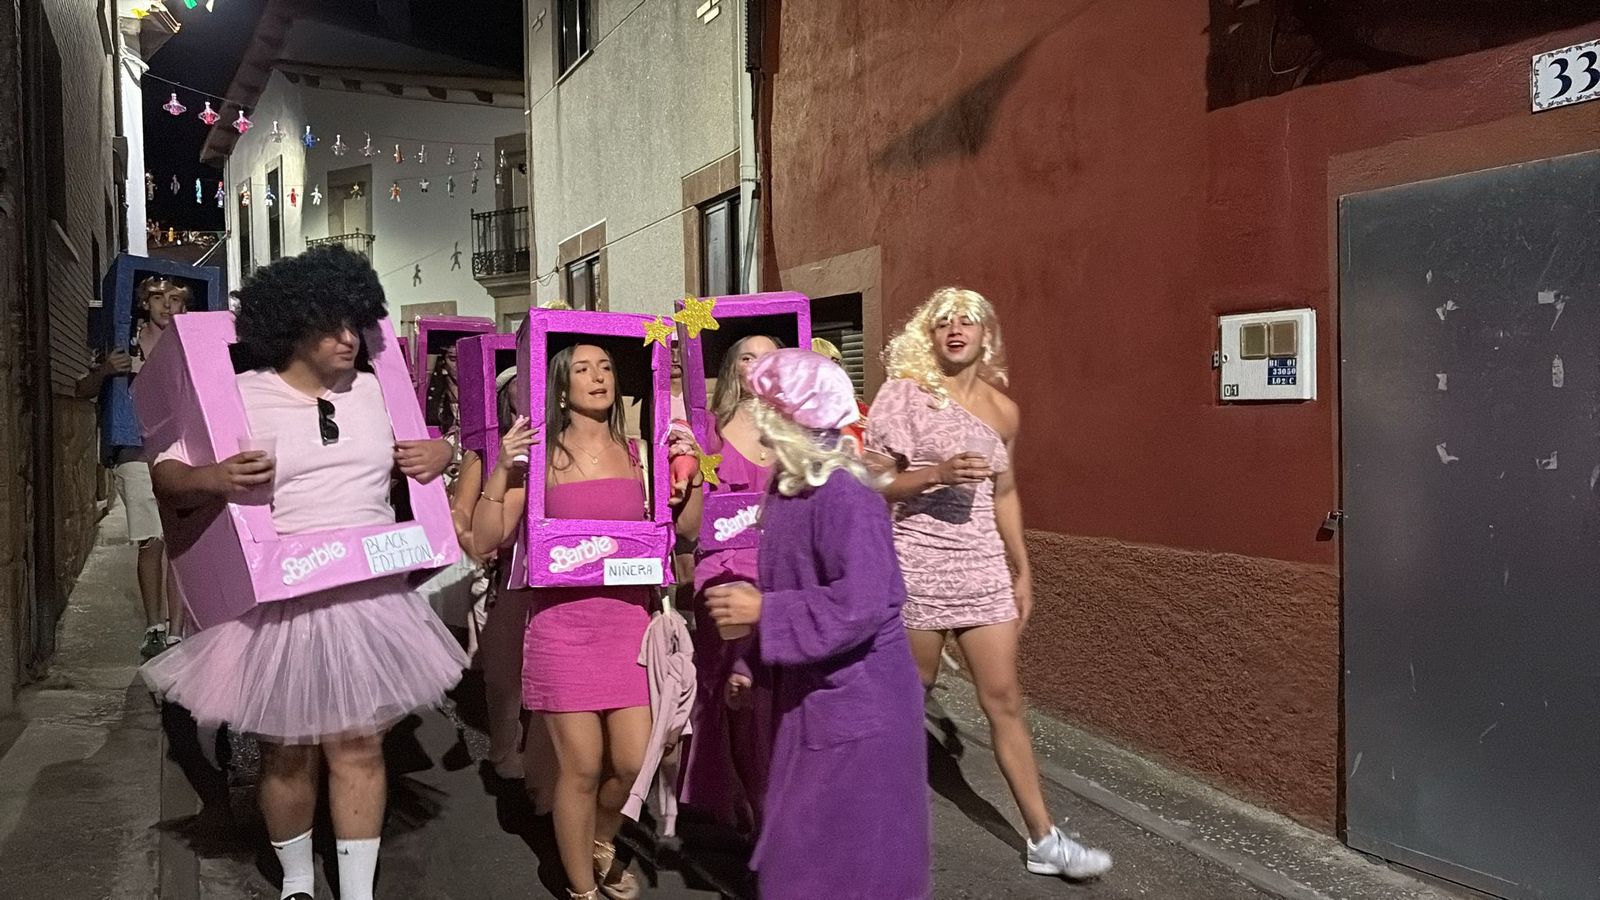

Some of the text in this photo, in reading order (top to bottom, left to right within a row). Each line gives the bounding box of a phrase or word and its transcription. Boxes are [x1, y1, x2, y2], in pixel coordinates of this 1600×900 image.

[1548, 51, 1600, 99] 33
[1225, 385, 1238, 396] 01
[366, 532, 409, 556] BLACK
[549, 536, 616, 573] Barbie
[282, 541, 347, 585] Barbie
[371, 545, 433, 573] EDITION
[608, 562, 653, 576] NIÑERA
